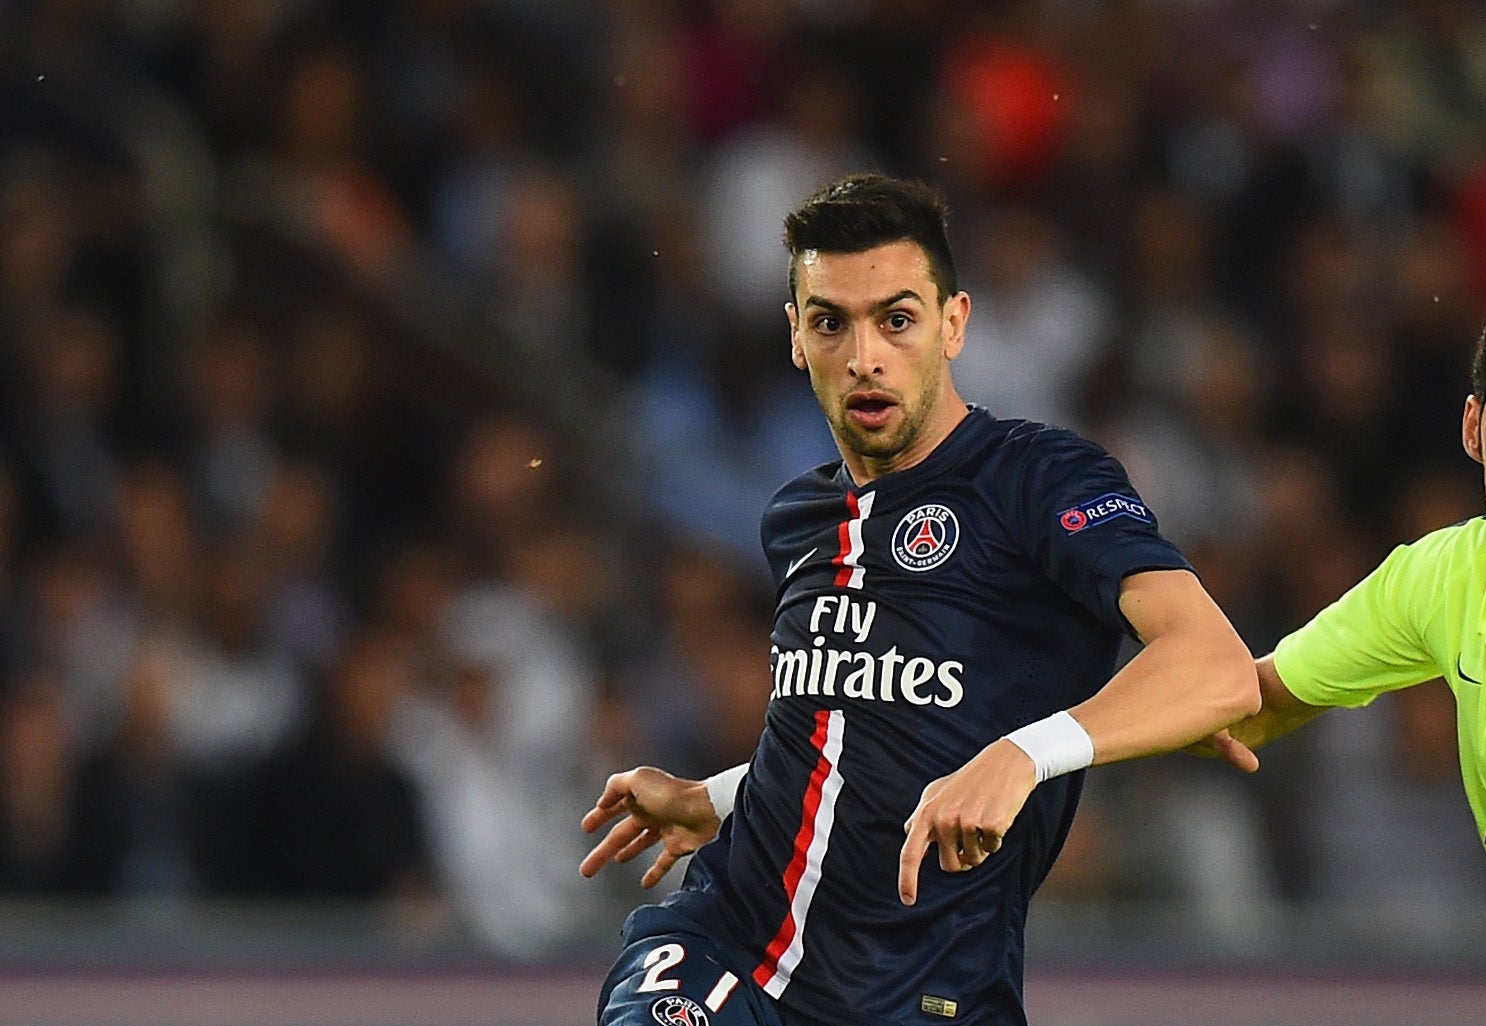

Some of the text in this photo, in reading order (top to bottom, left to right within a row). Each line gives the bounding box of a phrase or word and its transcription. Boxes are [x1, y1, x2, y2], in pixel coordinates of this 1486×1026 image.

[905, 507, 950, 525] PARIS
[1086, 498, 1147, 520] RESPECT
[809, 594, 876, 643] Fly
